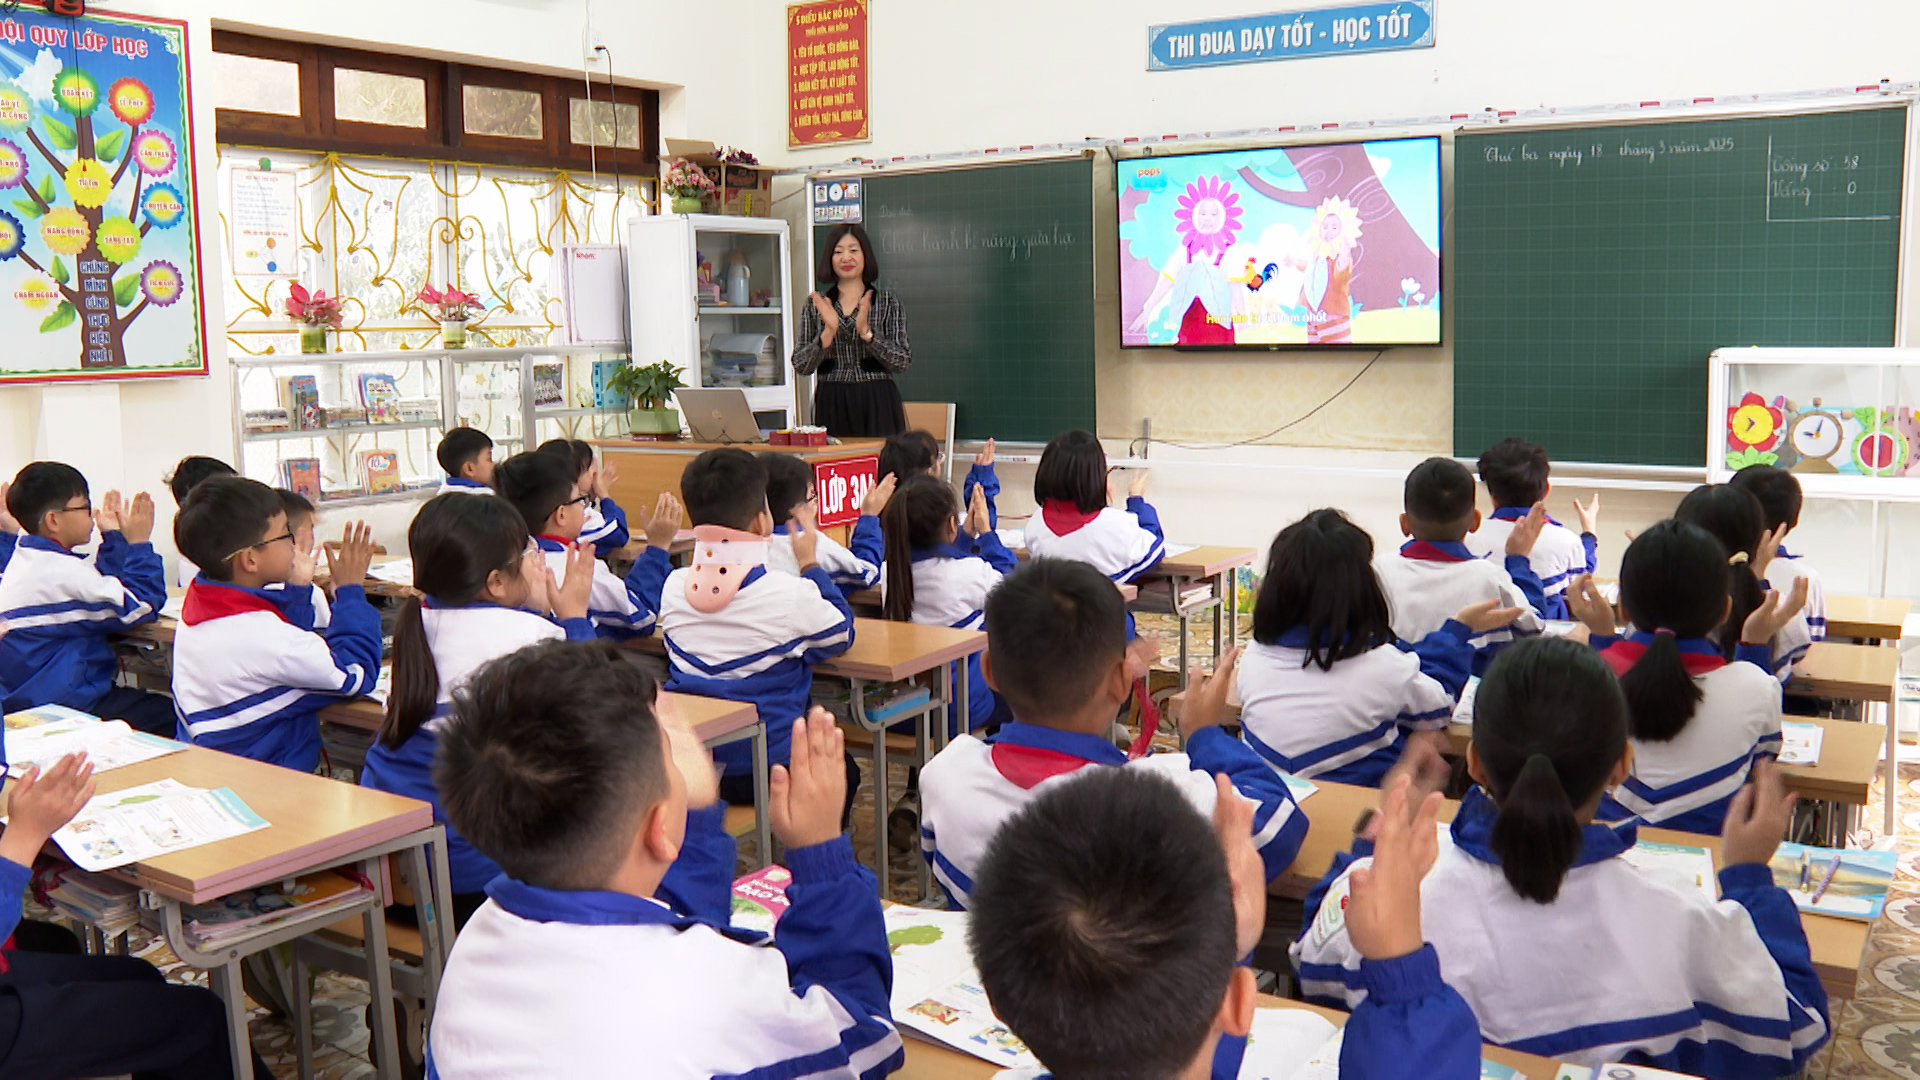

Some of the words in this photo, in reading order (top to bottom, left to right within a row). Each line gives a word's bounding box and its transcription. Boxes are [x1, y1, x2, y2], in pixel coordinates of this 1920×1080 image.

[30, 25, 68, 48] QUY
[72, 28, 107, 52] LỚP
[112, 36, 148, 60] HỌC
[1168, 35, 1195, 59] THI
[1200, 31, 1235, 56] ĐUA
[1241, 25, 1276, 56] DẠY
[1281, 13, 1314, 48] TỐT
[1332, 17, 1371, 48] HỌC
[1377, 6, 1412, 40] TỐT
[1484, 144, 1515, 162] Thứ
[1521, 143, 1539, 161] ba
[1549, 145, 1583, 168] ngày
[1591, 143, 1603, 158] 18
[1620, 138, 1655, 164] tháng
[1659, 139, 1665, 154] 3
[1669, 140, 1701, 154] năm
[1703, 137, 1734, 152] 2025
[821, 468, 847, 515] LỚP
